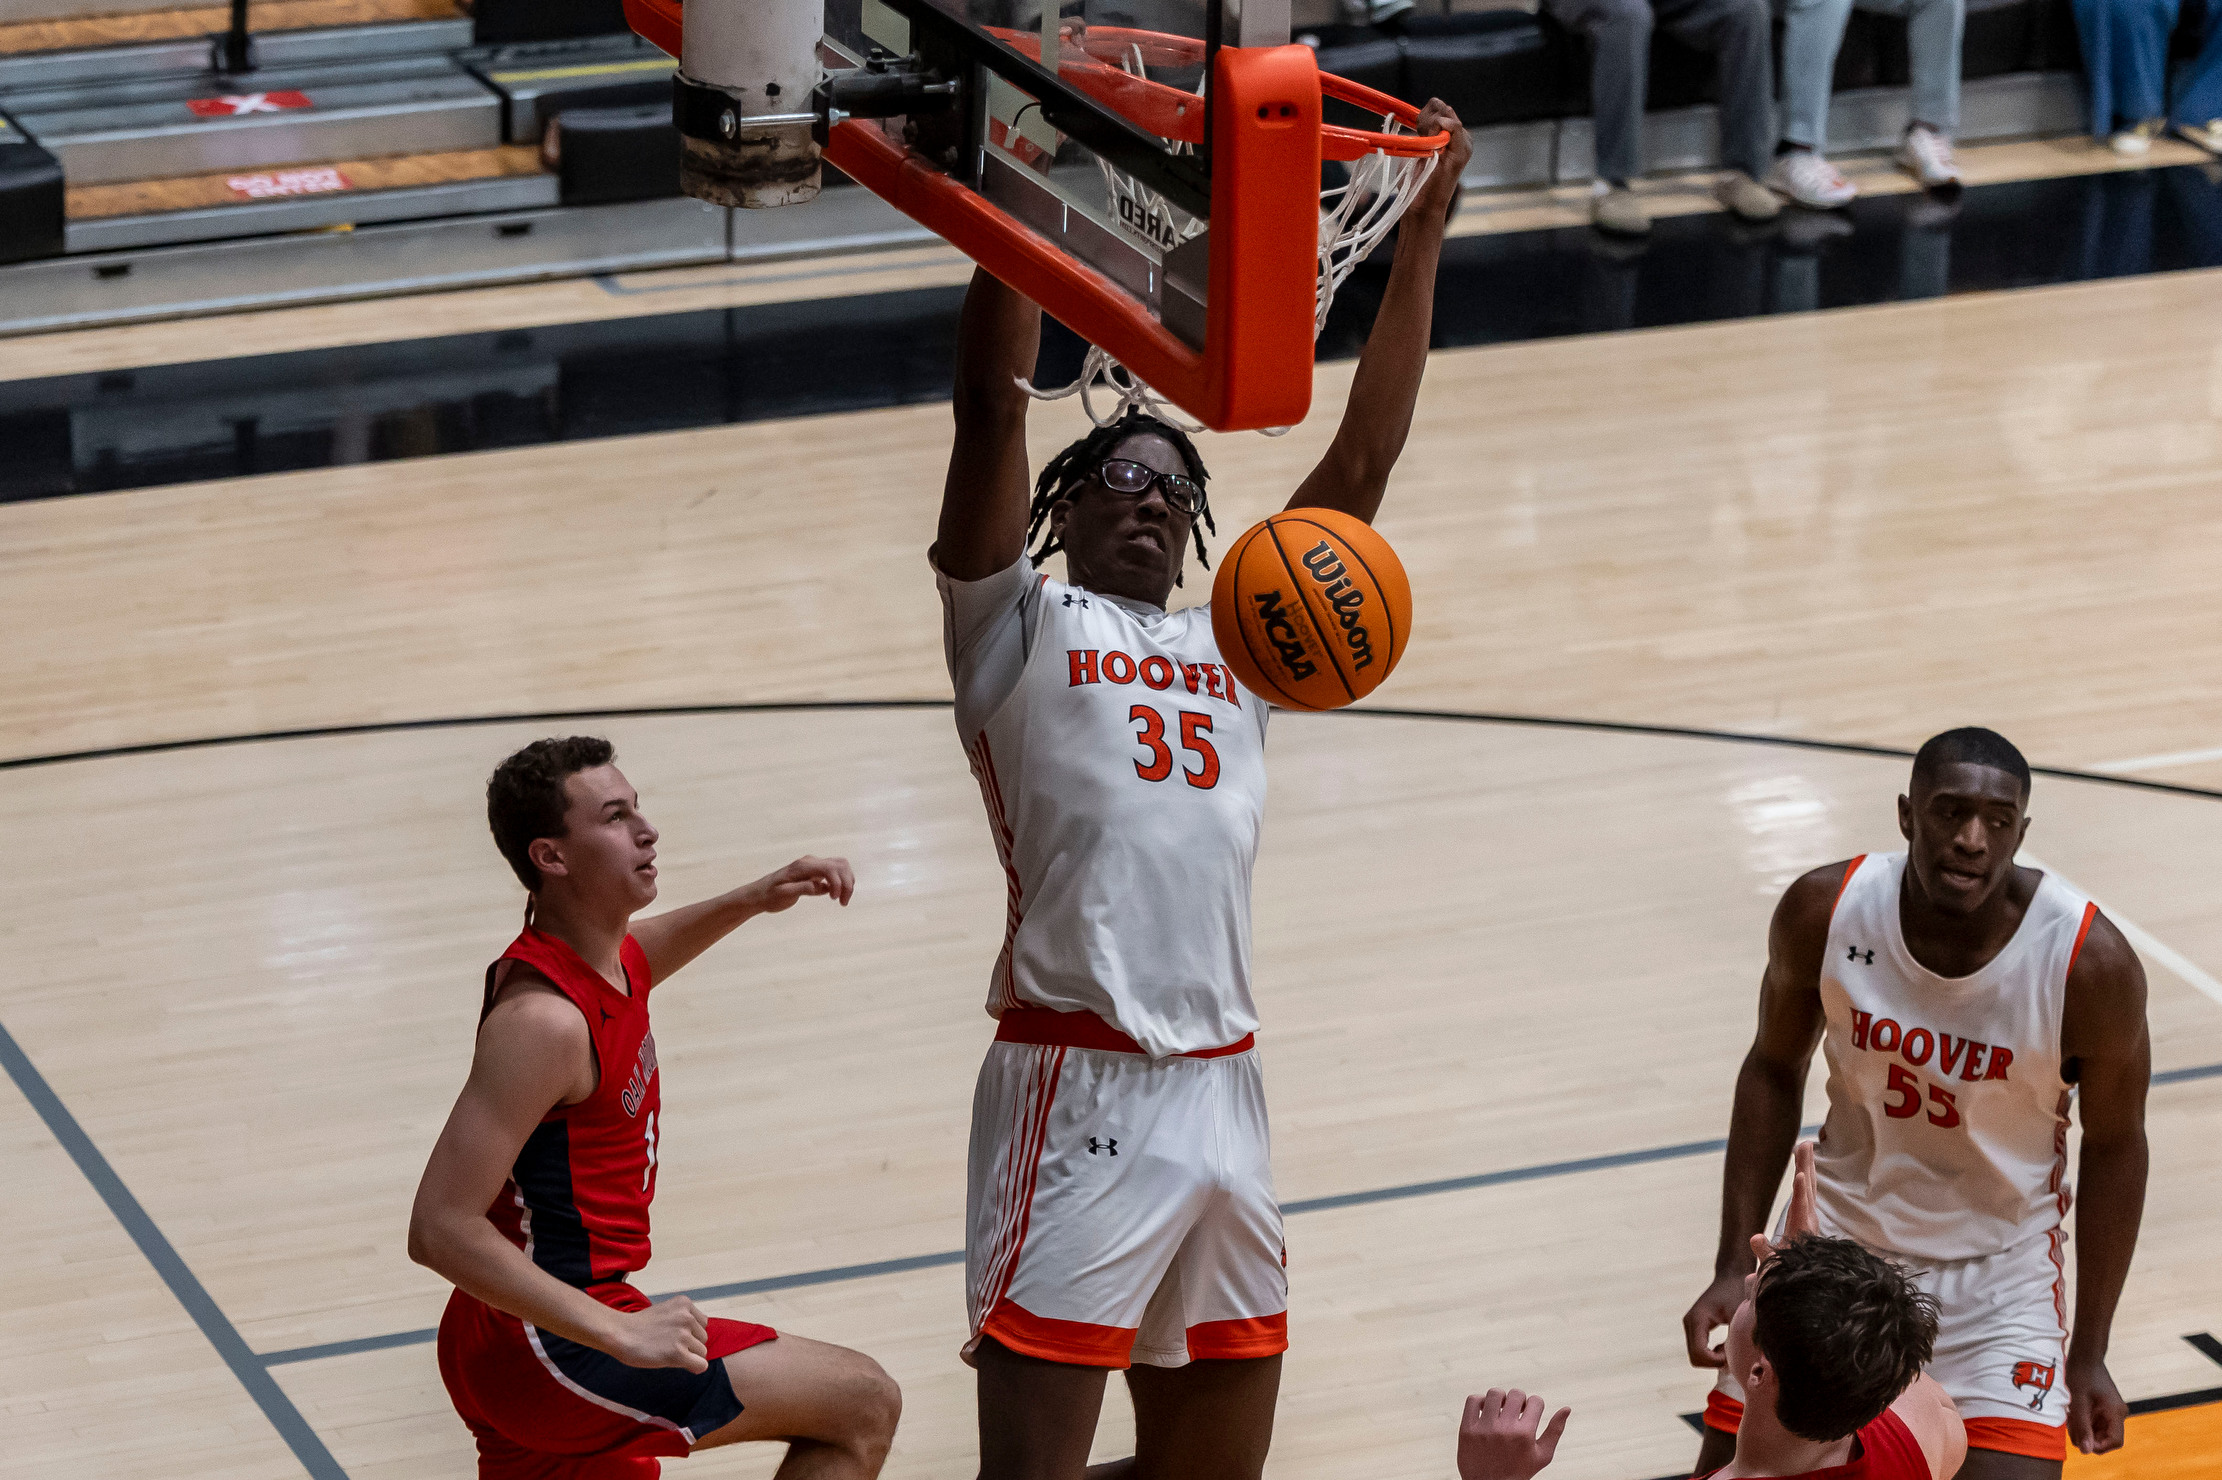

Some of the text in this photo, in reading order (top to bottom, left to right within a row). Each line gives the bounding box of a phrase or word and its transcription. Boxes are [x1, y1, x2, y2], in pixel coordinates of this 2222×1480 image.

[1254, 590, 1318, 682] NCAA
[1302, 540, 1373, 673] Wilson
[1128, 704, 1221, 790] 35
[1849, 1007, 2014, 1083] HOOVER
[1883, 1062, 1961, 1129] 55
